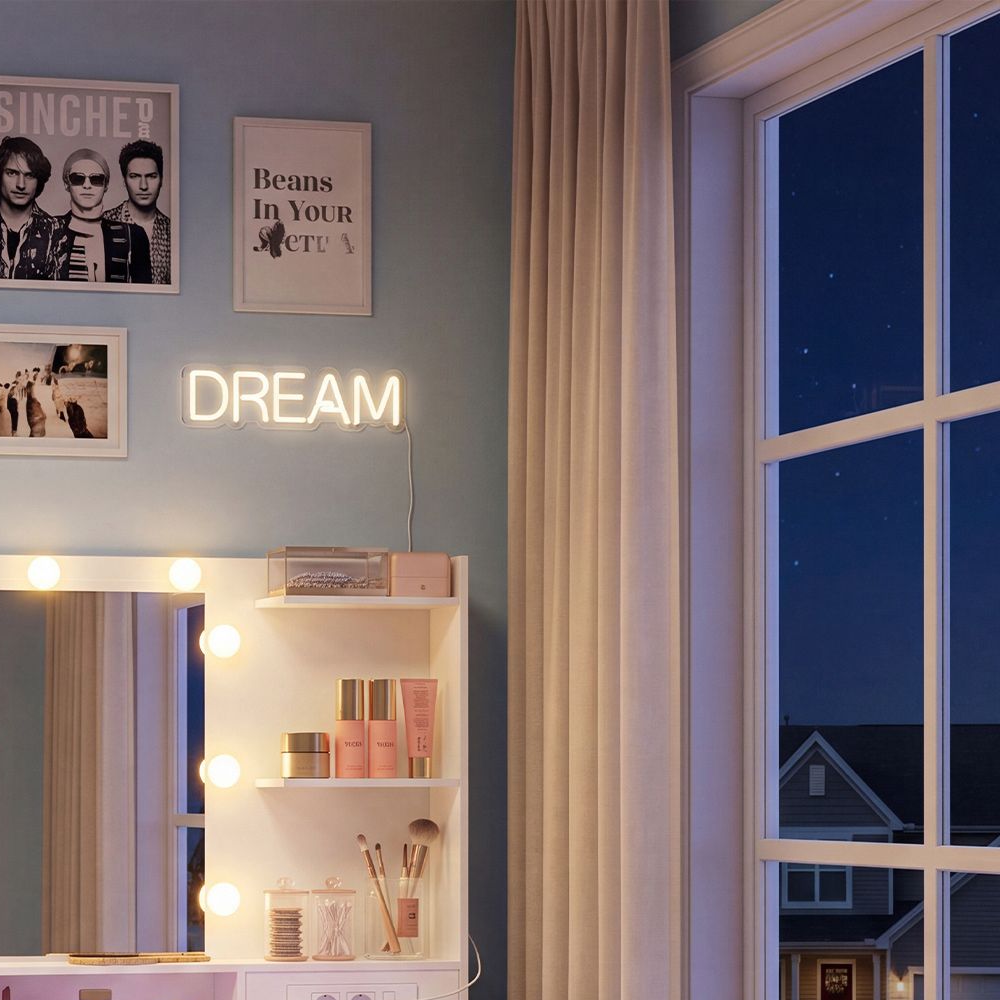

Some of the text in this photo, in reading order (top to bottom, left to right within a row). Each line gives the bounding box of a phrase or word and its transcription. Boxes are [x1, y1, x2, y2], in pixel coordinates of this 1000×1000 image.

[253, 168, 333, 192] Beans
[253, 199, 279, 220] In
[189, 369, 400, 426] DREAM
